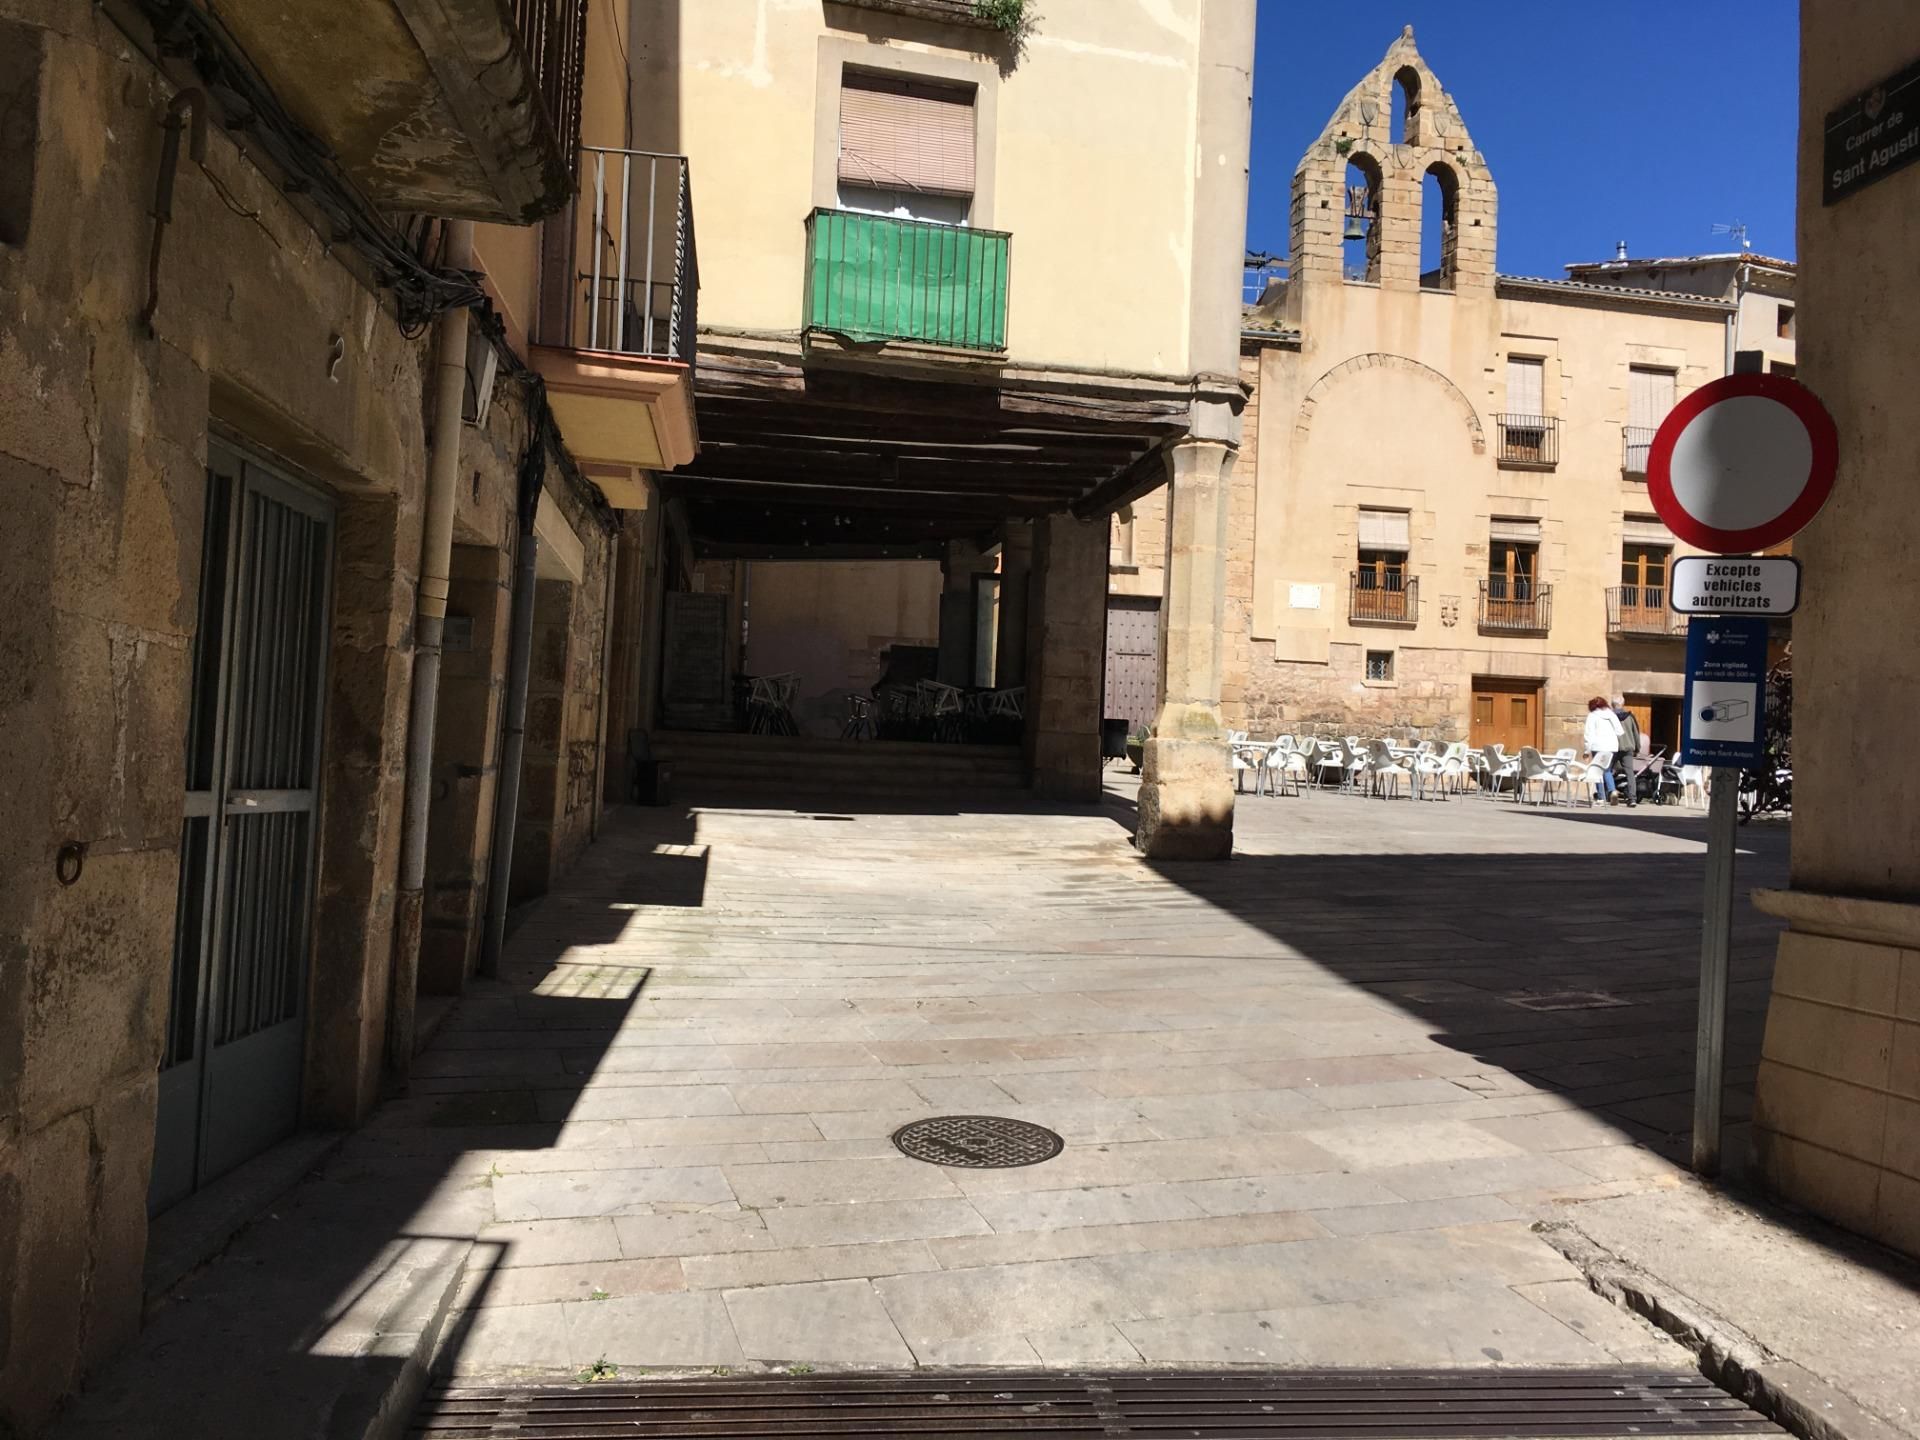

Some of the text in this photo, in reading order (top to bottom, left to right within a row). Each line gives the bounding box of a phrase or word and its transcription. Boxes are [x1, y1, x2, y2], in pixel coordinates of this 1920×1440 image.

[1846, 112, 1904, 151] Carrer de
[1832, 158, 1865, 189] Sant
[1706, 563, 1761, 578] Excepte
[1704, 579, 1762, 592] vehicles
[1692, 595, 1771, 608] autoritzats
